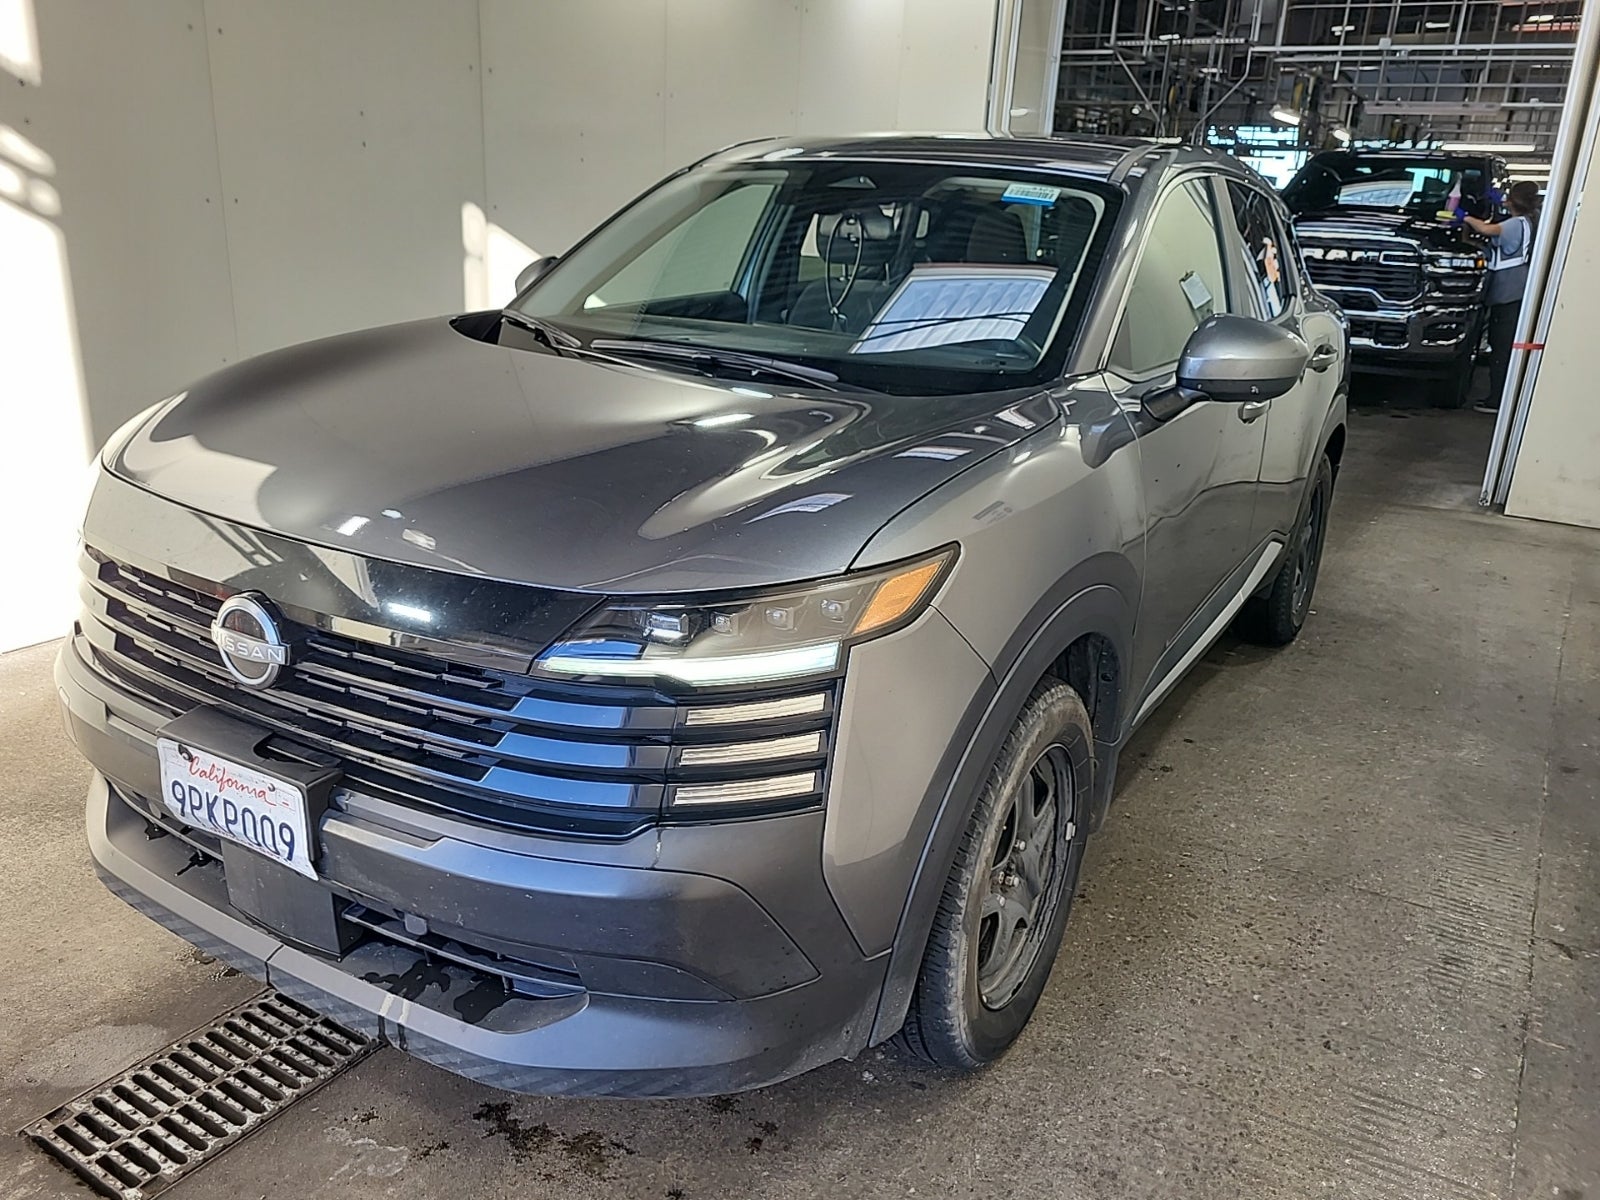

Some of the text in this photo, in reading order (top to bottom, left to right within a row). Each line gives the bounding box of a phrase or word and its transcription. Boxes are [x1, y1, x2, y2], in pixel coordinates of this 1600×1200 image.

[1302, 247, 1380, 261] RAM
[212, 627, 282, 662] NISSAN
[189, 756, 277, 807] California
[171, 780, 295, 862] 9PKP009
